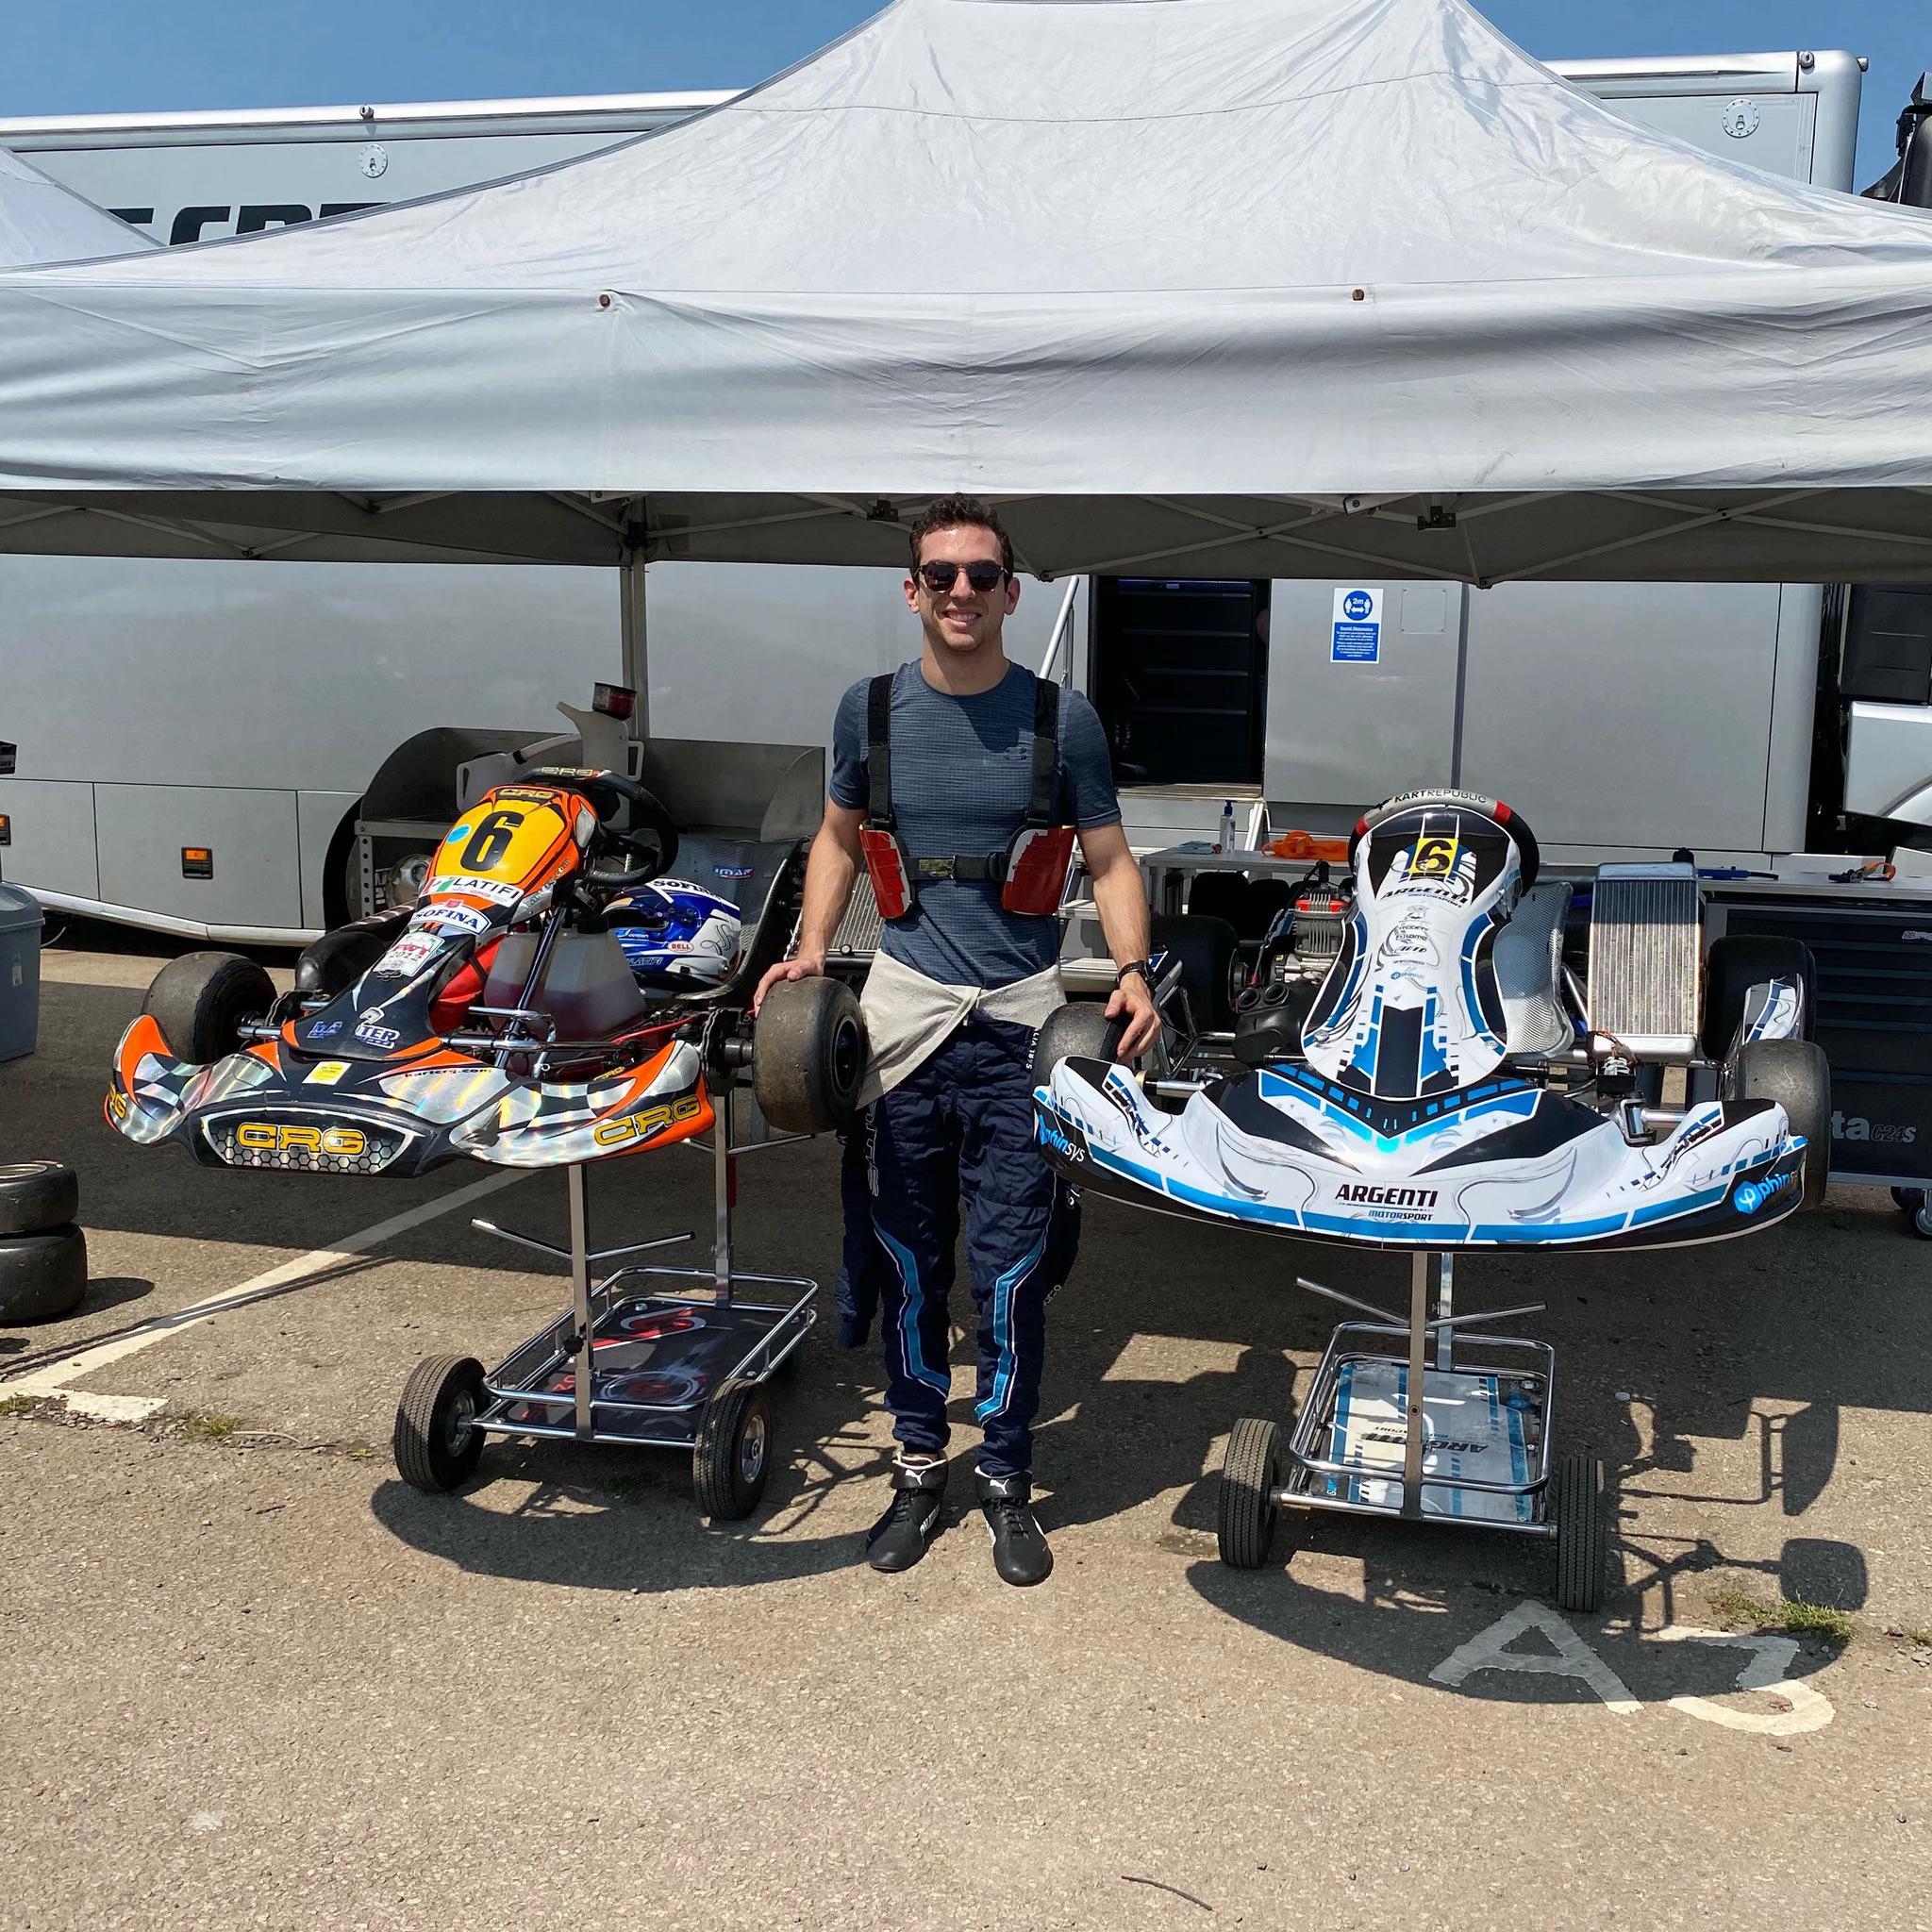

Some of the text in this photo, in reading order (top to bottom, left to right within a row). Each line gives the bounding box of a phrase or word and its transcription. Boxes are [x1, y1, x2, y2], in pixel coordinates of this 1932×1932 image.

[459, 810, 525, 873] 6
[1416, 839, 1453, 873] 6
[452, 877, 521, 900] LATIFI
[415, 908, 478, 930] SOFINA
[593, 1093, 702, 1146] CRG
[237, 1122, 366, 1157] CRG
[1335, 1183, 1439, 1208] ARGENTI
[1369, 1210, 1433, 1222] MOTORSPORT
